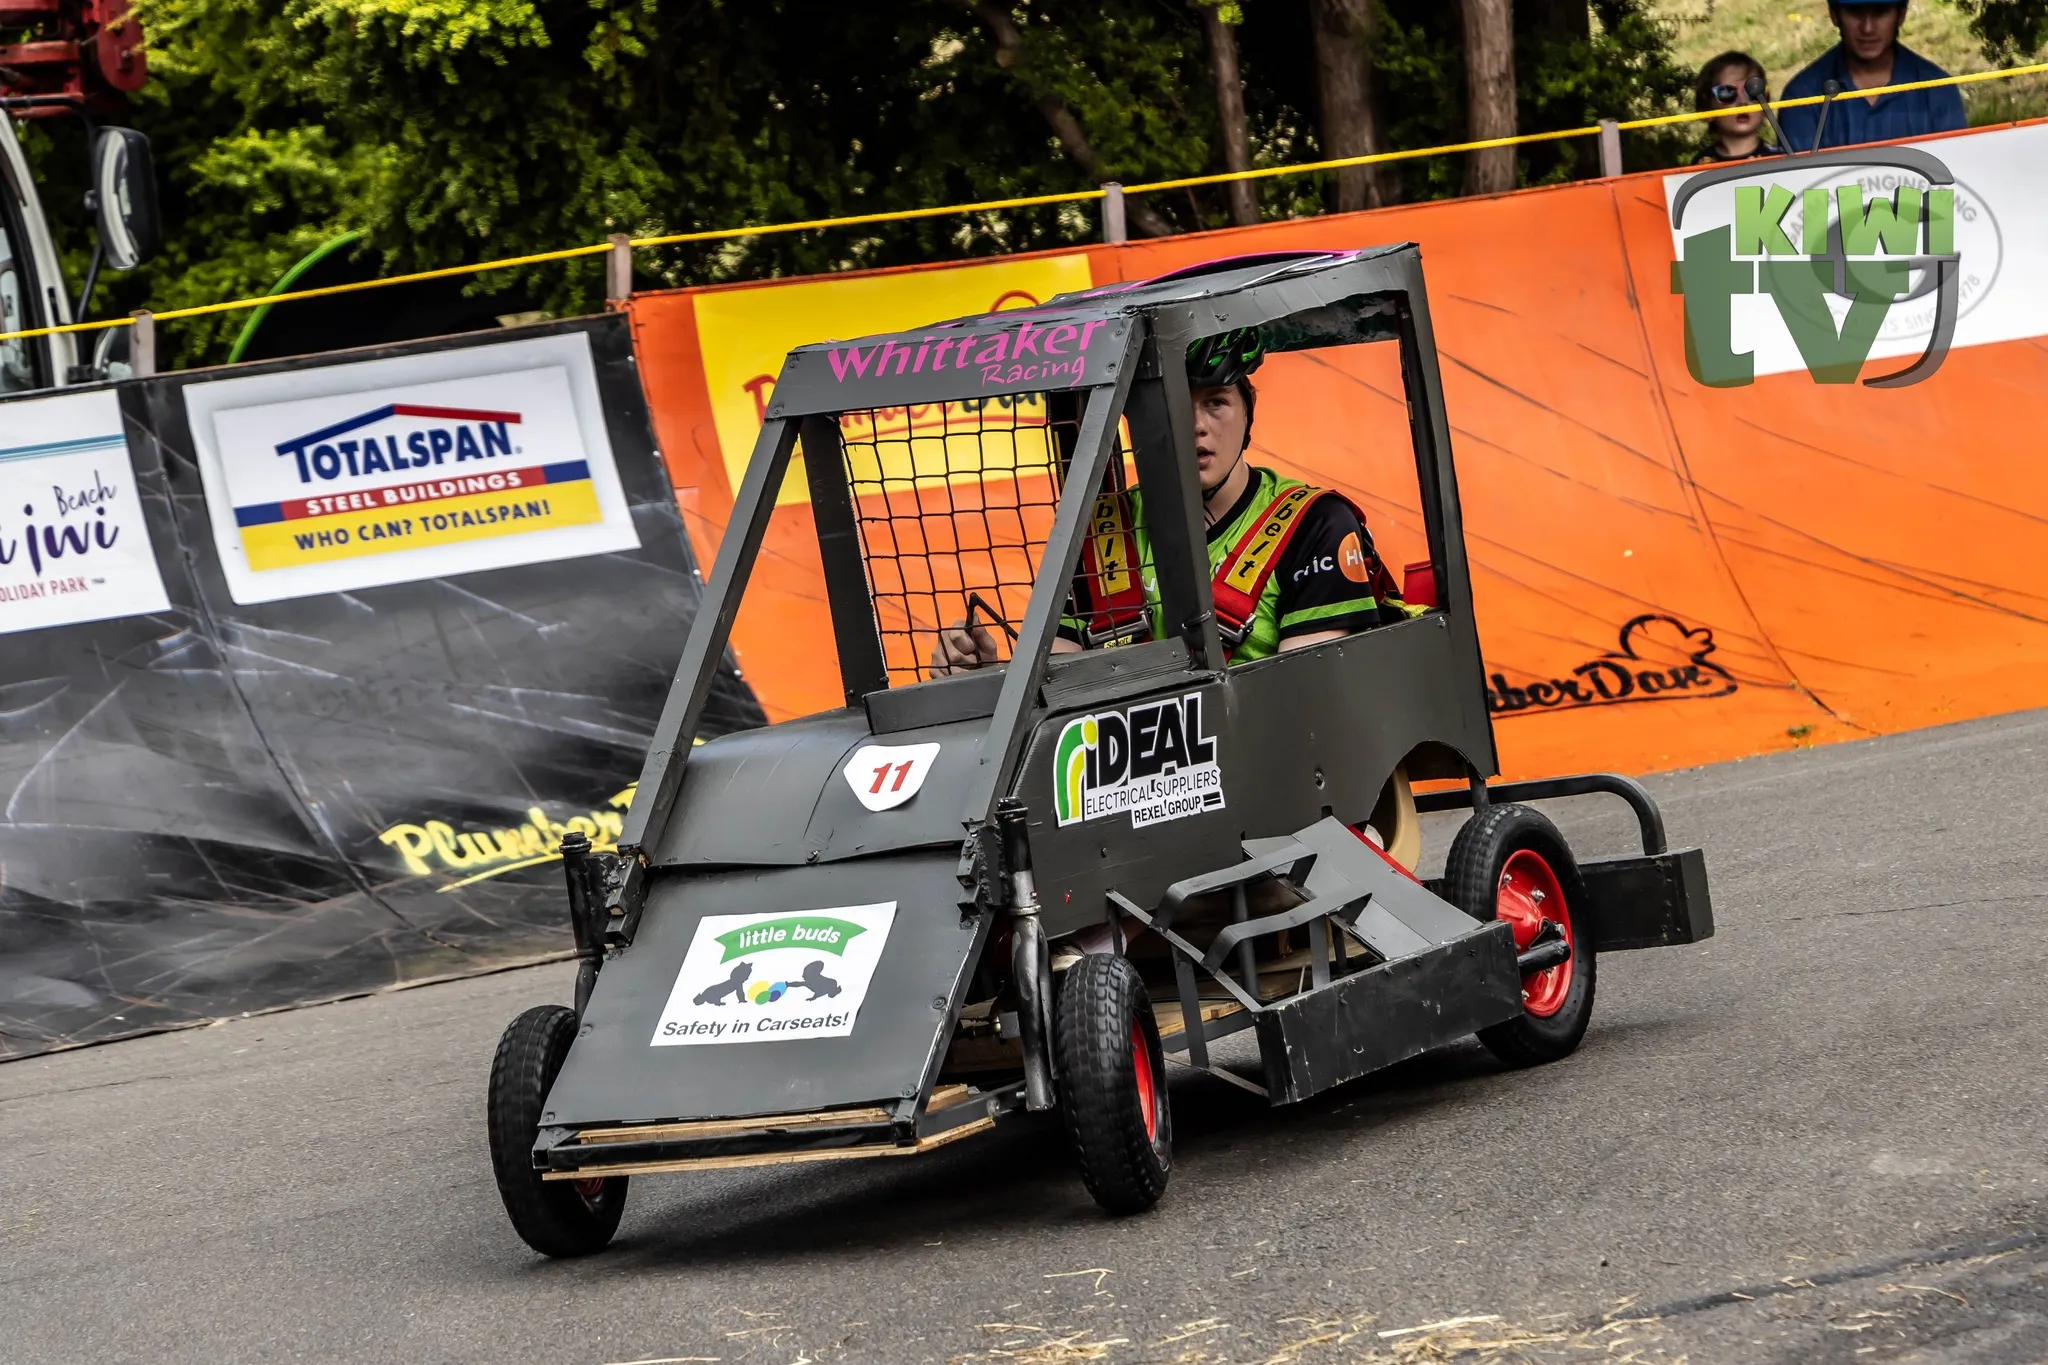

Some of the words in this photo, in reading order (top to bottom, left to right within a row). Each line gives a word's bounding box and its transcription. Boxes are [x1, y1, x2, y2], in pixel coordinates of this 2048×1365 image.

[828, 319, 1107, 383] Whittaker
[981, 356, 1085, 387] Racing
[275, 421, 513, 483] TOTALSPAN
[52, 469, 117, 517] Beach
[306, 492, 371, 516] STEEL
[383, 471, 523, 504] BUILDINGS
[294, 528, 350, 550] WHO
[357, 518, 413, 541] CAN?
[419, 498, 552, 532] TOTALSPAN!
[0, 581, 46, 602] OLIDAY
[50, 576, 89, 595] PARK
[1573, 660, 1712, 700] Dan
[868, 759, 914, 794] 11
[1086, 785, 1153, 815] ELECTRICAL
[1156, 769, 1218, 798] SUPPLIERS
[1134, 807, 1166, 824] REXEL
[1168, 795, 1201, 815] GROUP
[739, 926, 787, 949] little
[791, 924, 841, 944] buds
[662, 1020, 728, 1038] Safety
[731, 1019, 750, 1034] in
[756, 1011, 850, 1032] Carseats!
